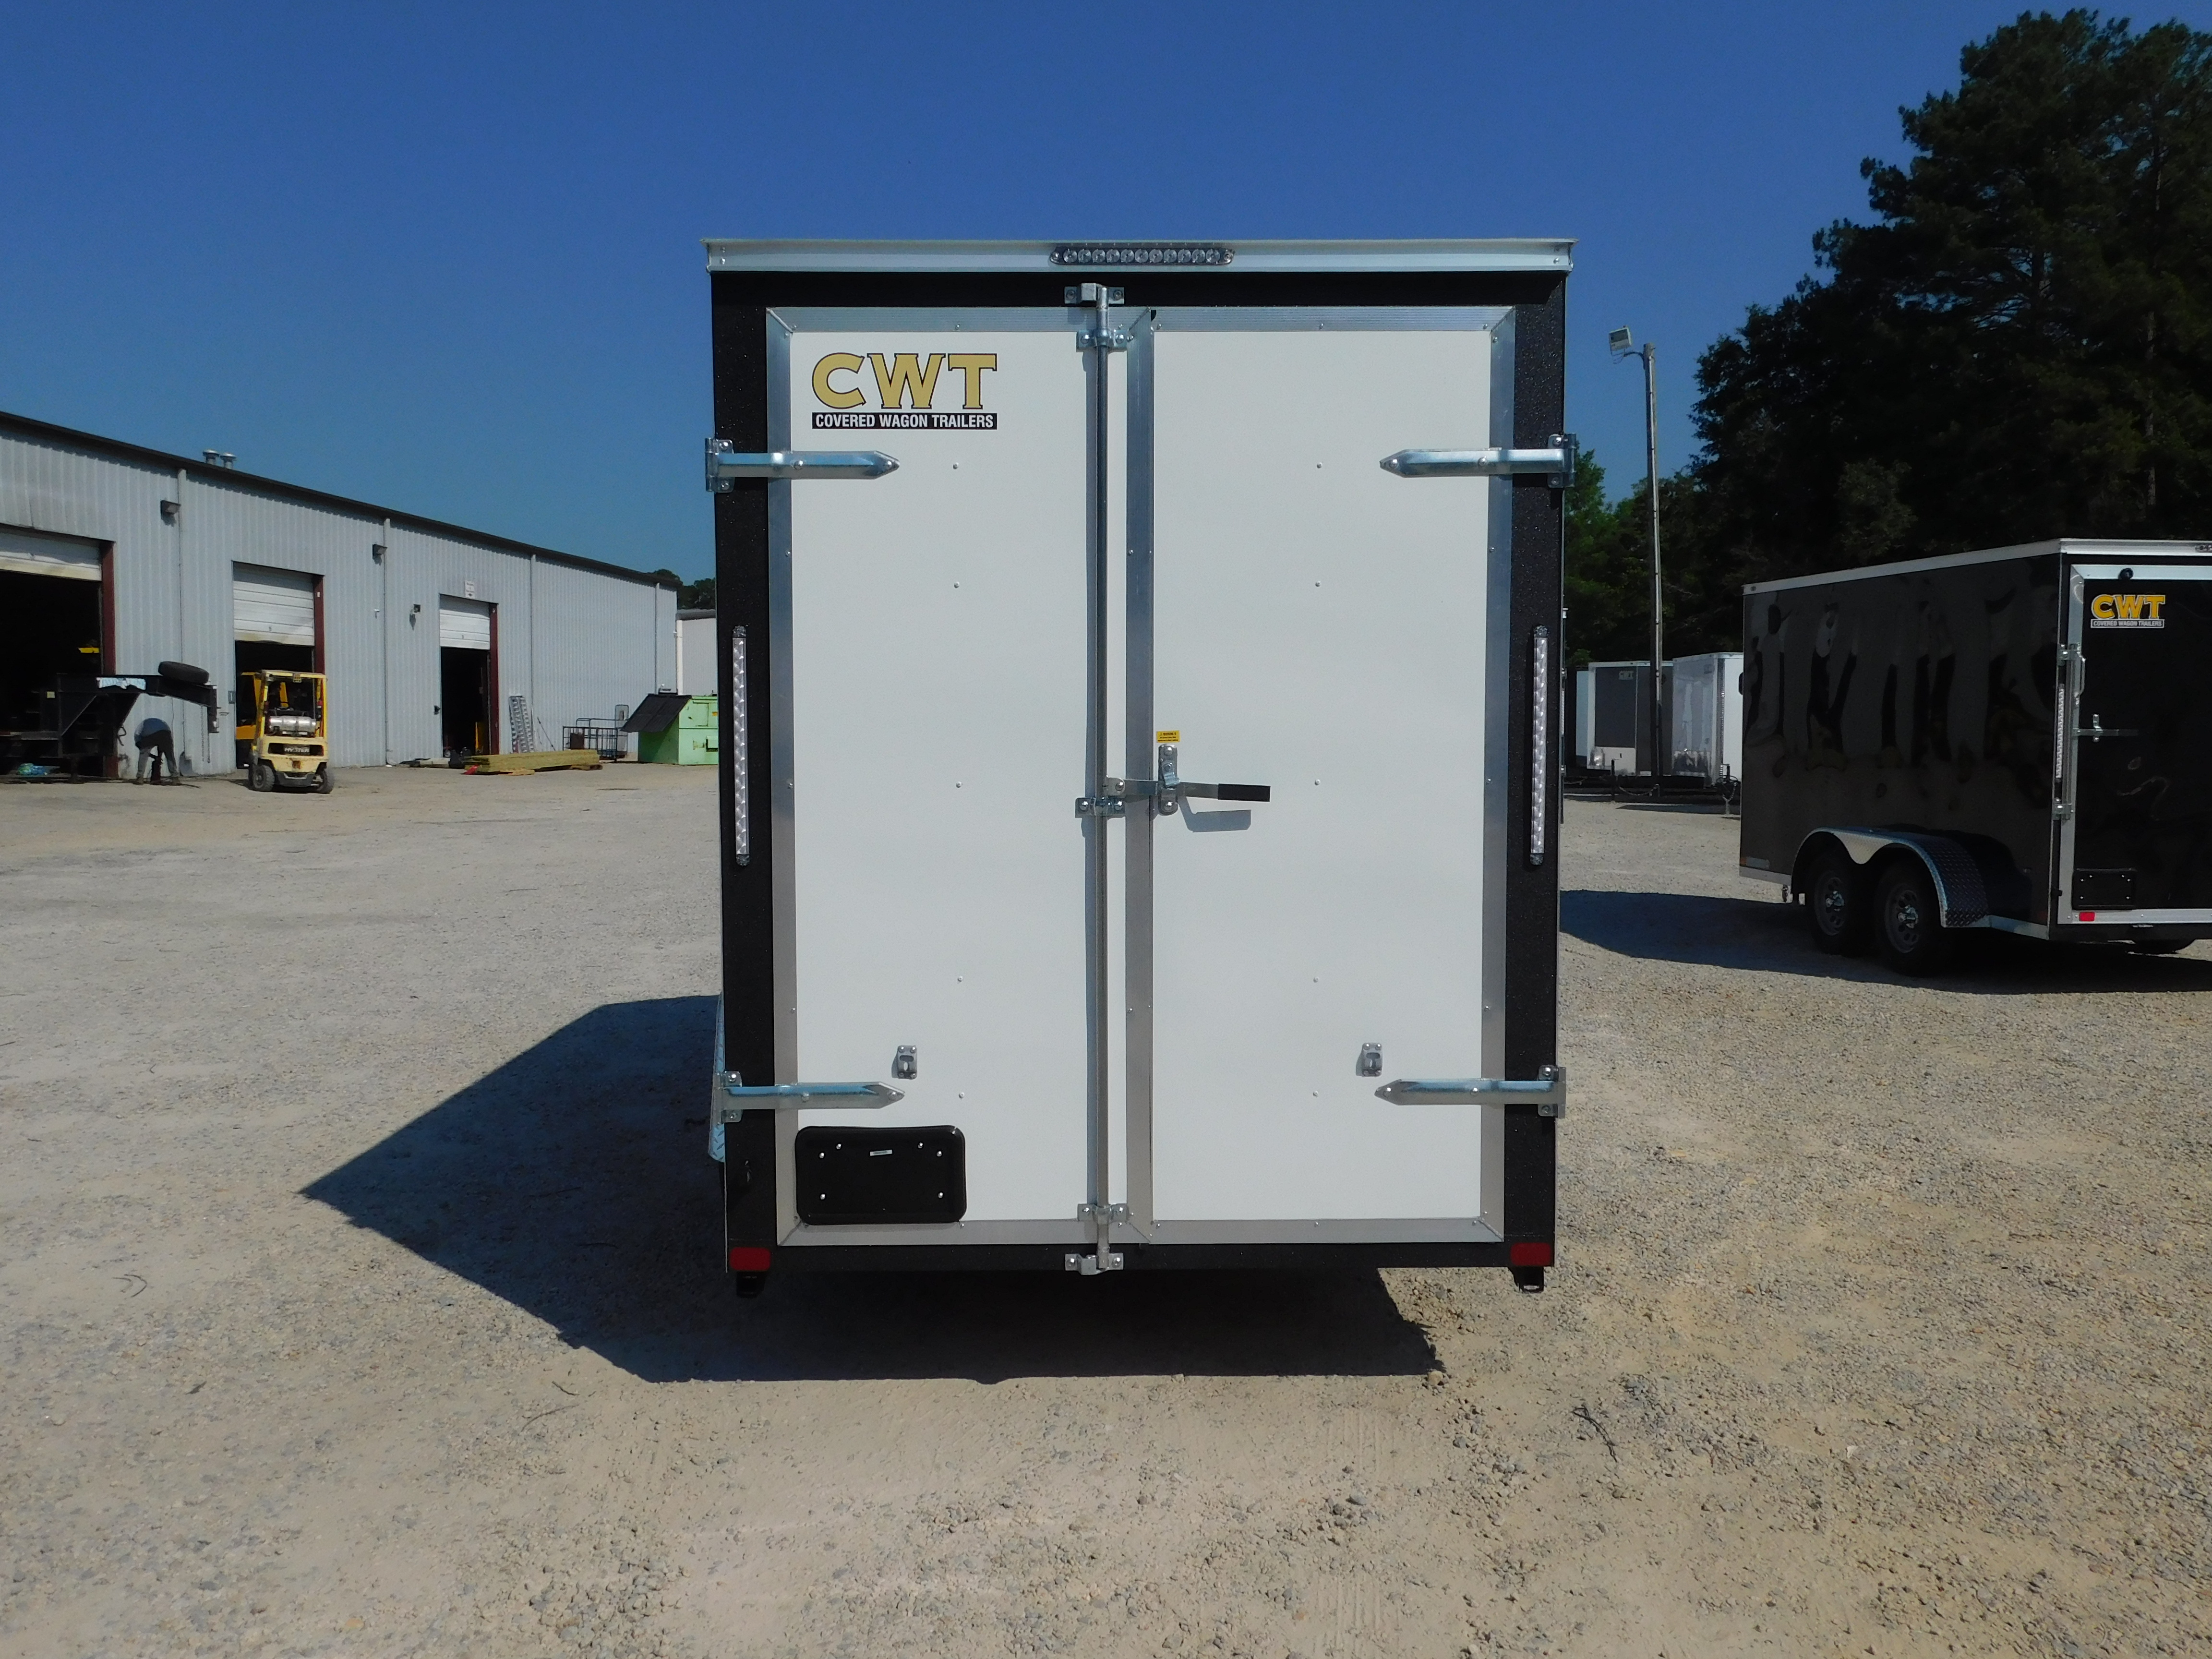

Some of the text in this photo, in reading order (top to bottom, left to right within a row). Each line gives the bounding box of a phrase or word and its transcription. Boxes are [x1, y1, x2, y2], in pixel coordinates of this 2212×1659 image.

[812, 352, 997, 409] CWT
[816, 414, 994, 428] COVERED WAGON TRAILERS
[2092, 594, 2165, 619] CWT
